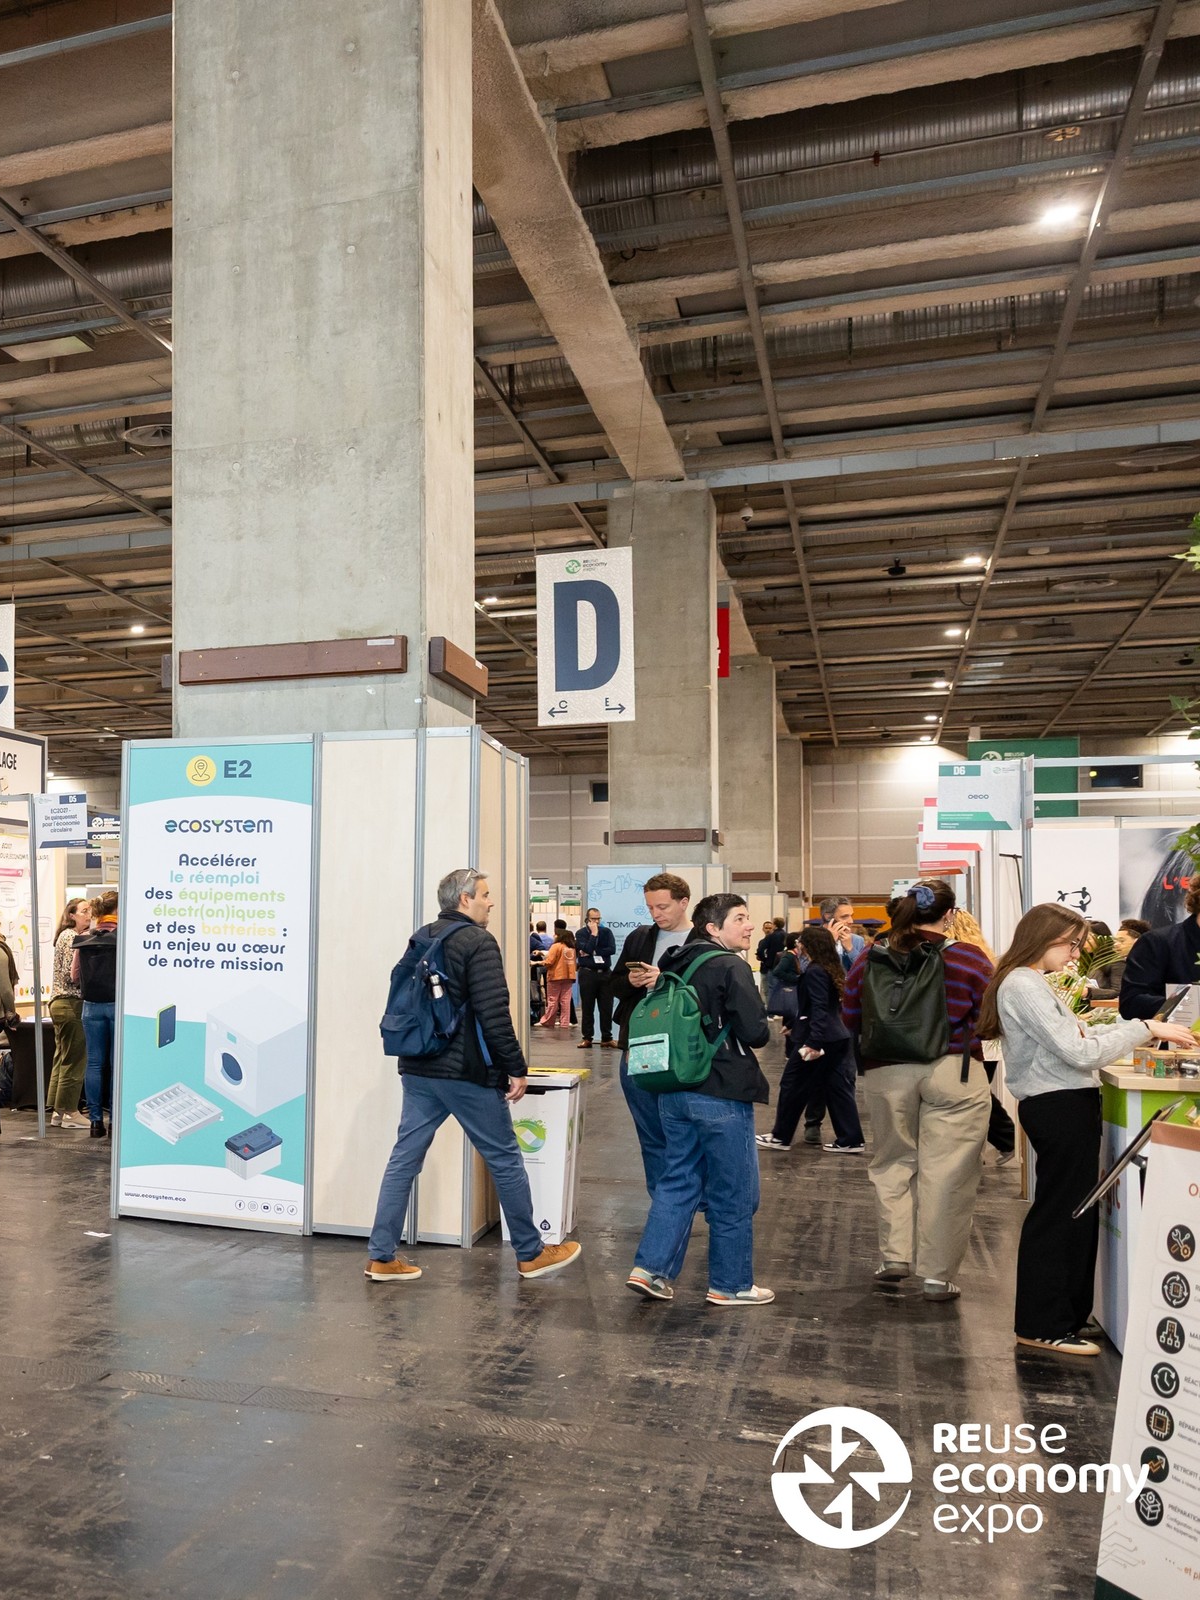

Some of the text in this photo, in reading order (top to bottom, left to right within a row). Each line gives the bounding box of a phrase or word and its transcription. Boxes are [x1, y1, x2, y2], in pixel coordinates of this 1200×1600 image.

[553, 579, 621, 692] D
[558, 700, 568, 709] C
[605, 698, 609, 706] E
[224, 760, 252, 778] E2
[953, 766, 966, 775] D6
[165, 819, 273, 834] ecosystem
[179, 854, 257, 867] Accélérer
[170, 871, 260, 887] le réemploi
[145, 888, 286, 905] des équipements
[153, 903, 276, 922] électr(on)iques
[146, 923, 162, 934] et
[167, 921, 196, 935] des
[202, 923, 277, 937] batteries
[143, 938, 286, 954] un enjeu au cœur
[148, 954, 284, 972] de notre mission
[125, 1192, 186, 1202] www.ecosystem.eco
